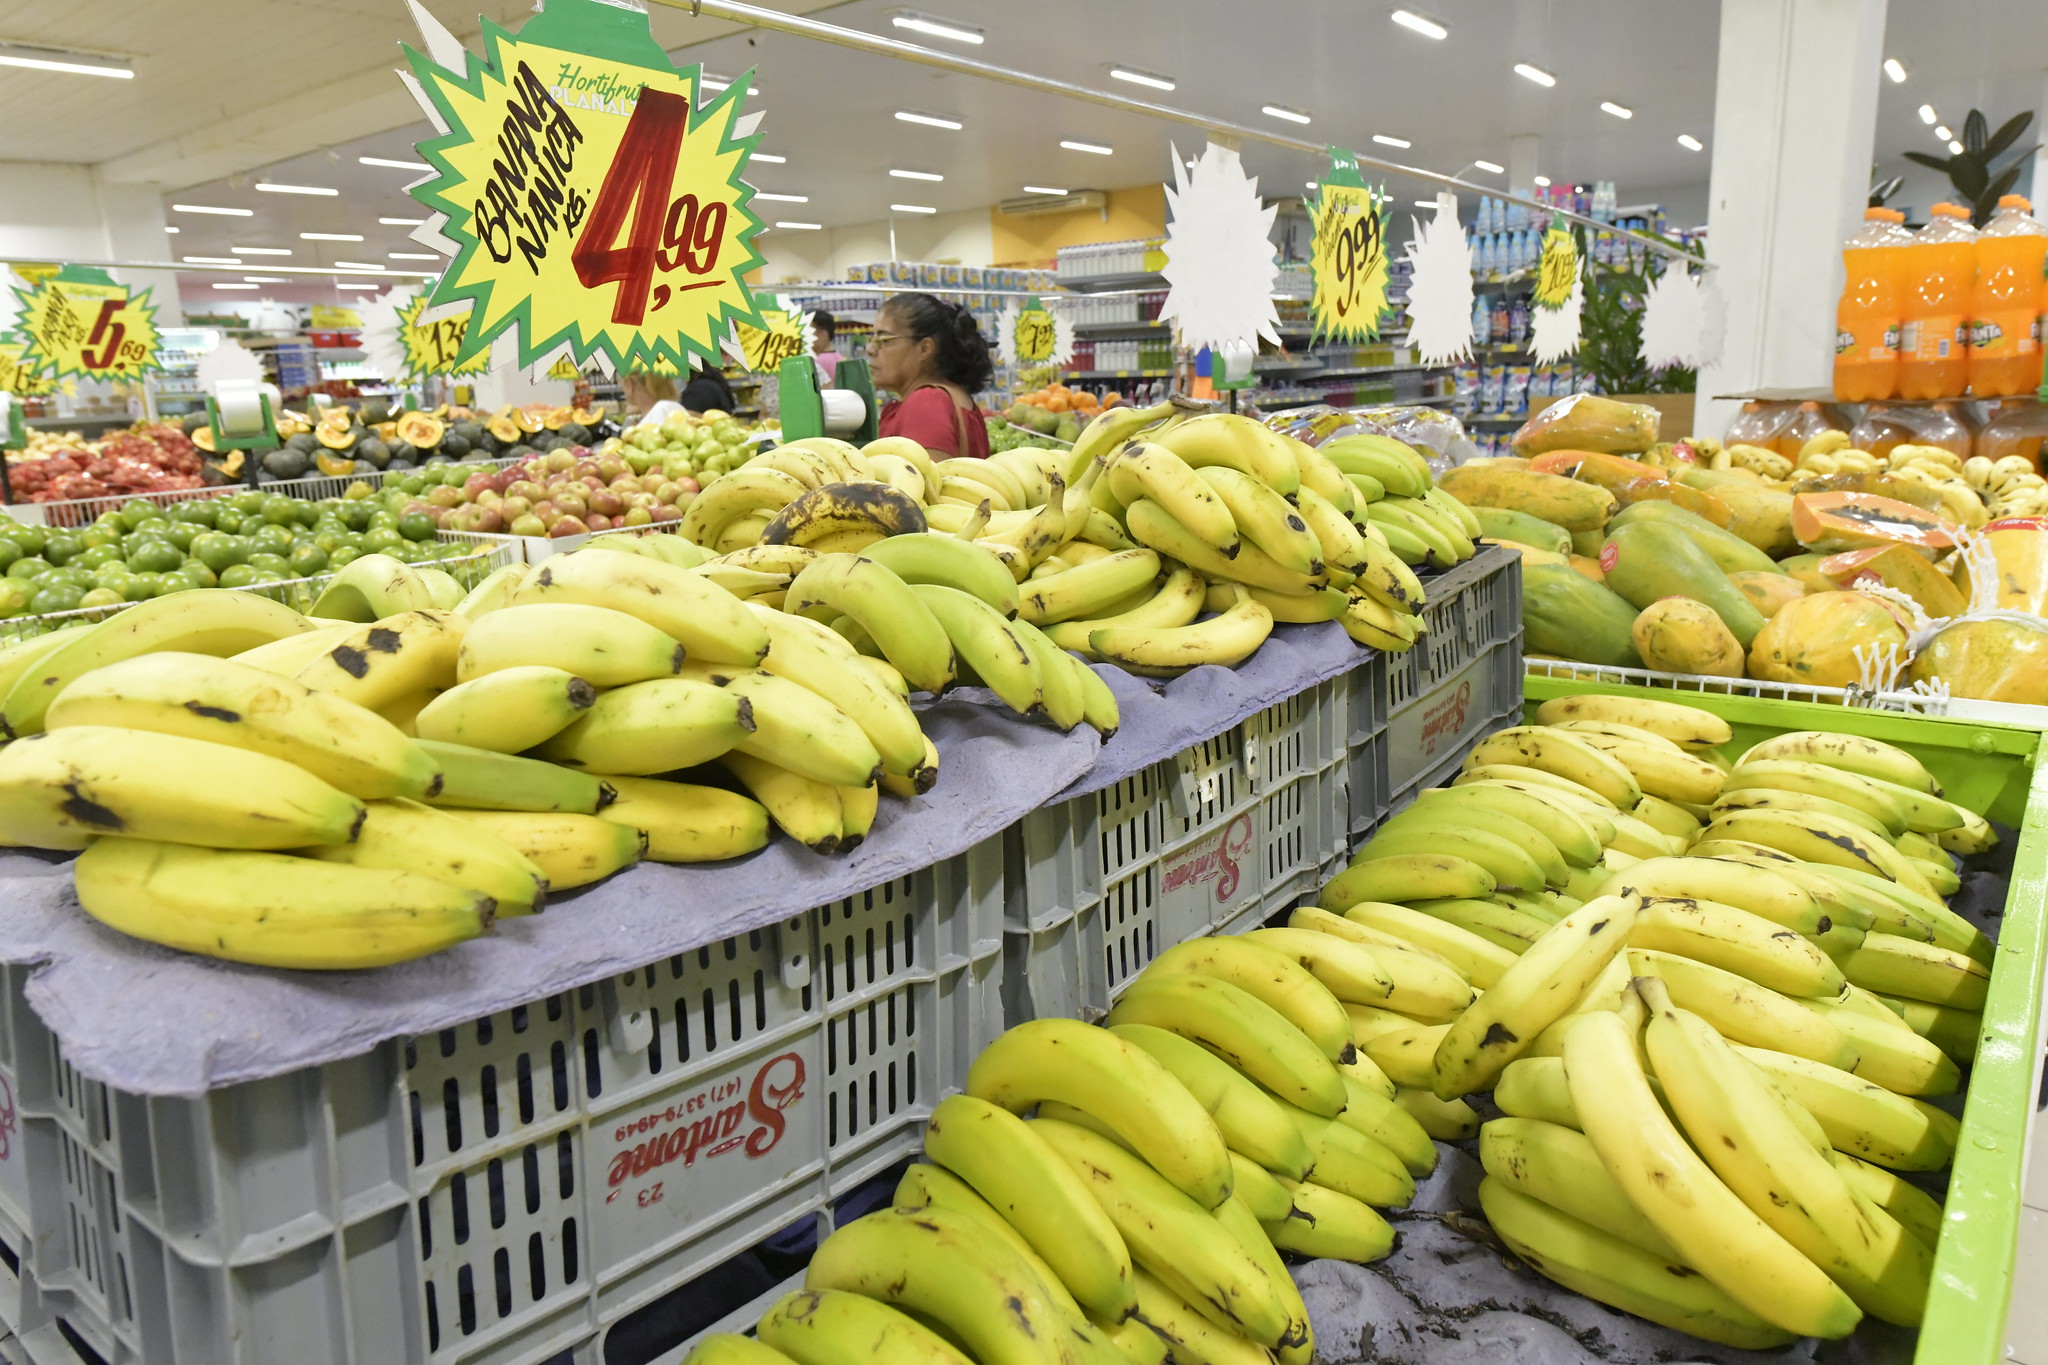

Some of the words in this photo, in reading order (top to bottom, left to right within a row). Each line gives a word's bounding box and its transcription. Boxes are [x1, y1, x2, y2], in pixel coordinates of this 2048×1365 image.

[475, 60, 548, 264] BANANA
[558, 63, 649, 105] Hortifrut
[516, 105, 584, 276] NANICA
